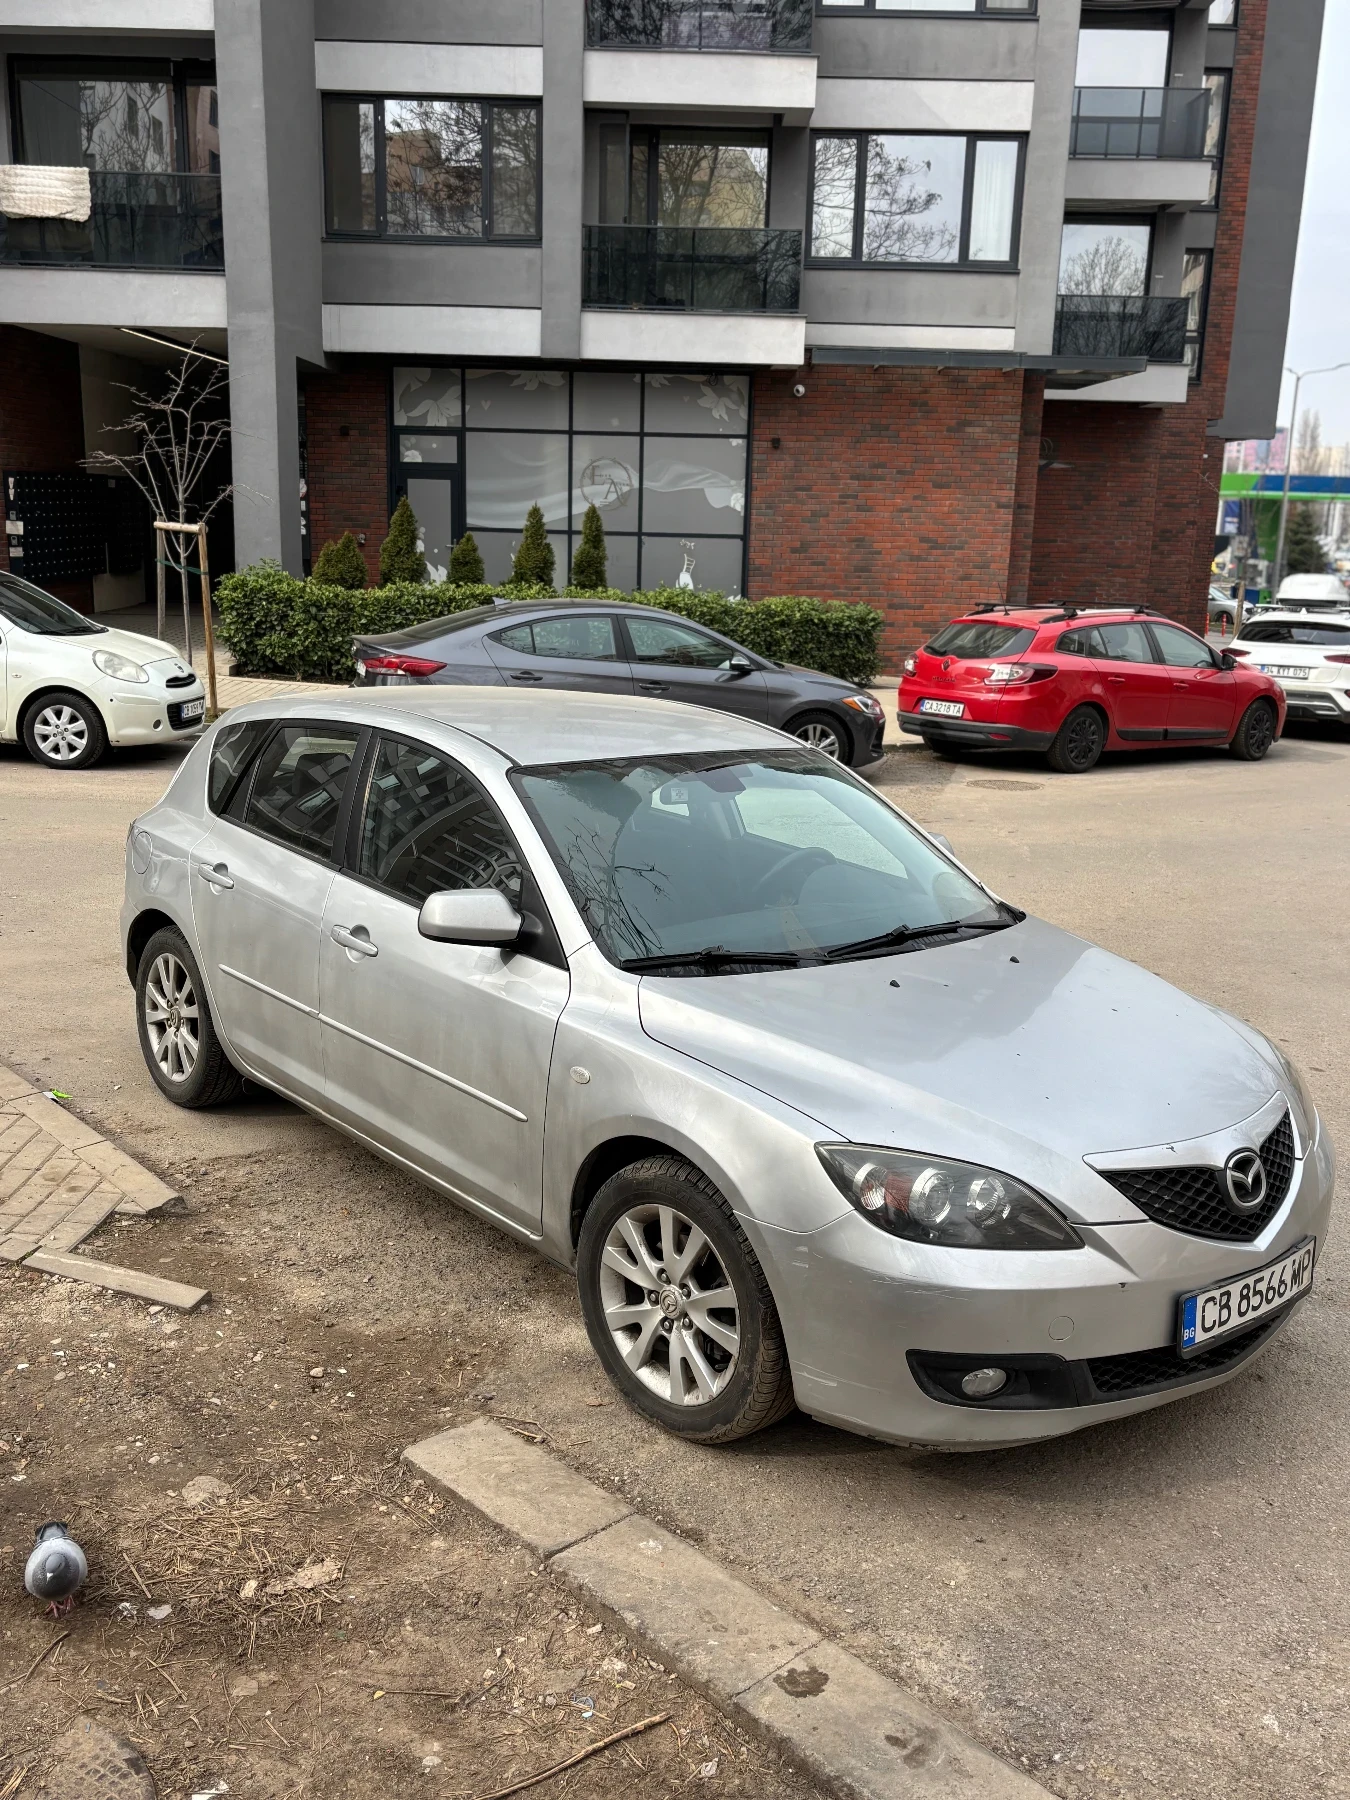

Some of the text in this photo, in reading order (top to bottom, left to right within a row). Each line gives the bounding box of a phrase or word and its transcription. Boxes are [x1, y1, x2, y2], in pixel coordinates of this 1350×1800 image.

[1293, 669, 1307, 677] 075
[925, 701, 961, 714] CA 3218 TA
[1201, 1248, 1311, 1333] CB 8566 MP
[1184, 1327, 1195, 1340] BG
